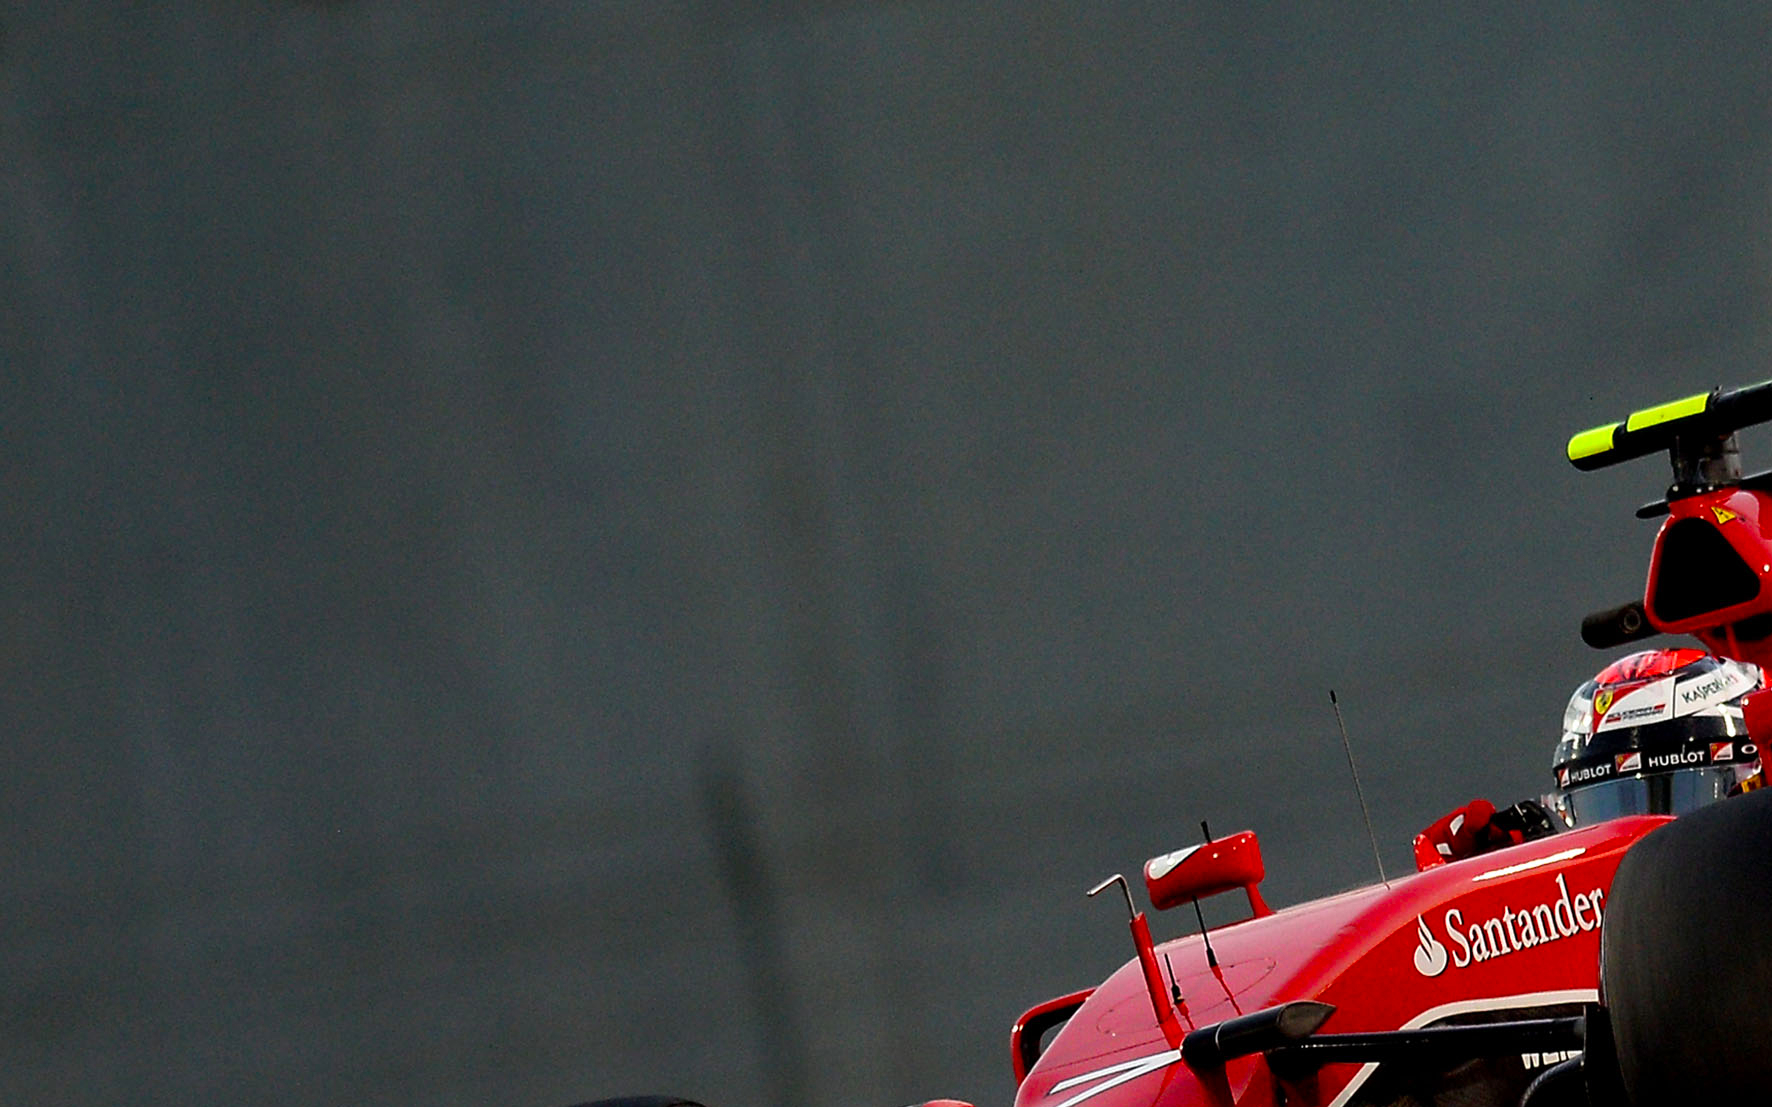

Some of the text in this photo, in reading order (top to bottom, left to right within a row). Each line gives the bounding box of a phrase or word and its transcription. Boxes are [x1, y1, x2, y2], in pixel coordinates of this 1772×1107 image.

[1649, 751, 1705, 768] HUBLOT
[1571, 763, 1612, 783] HUBLOT
[1445, 874, 1603, 968] Santander
